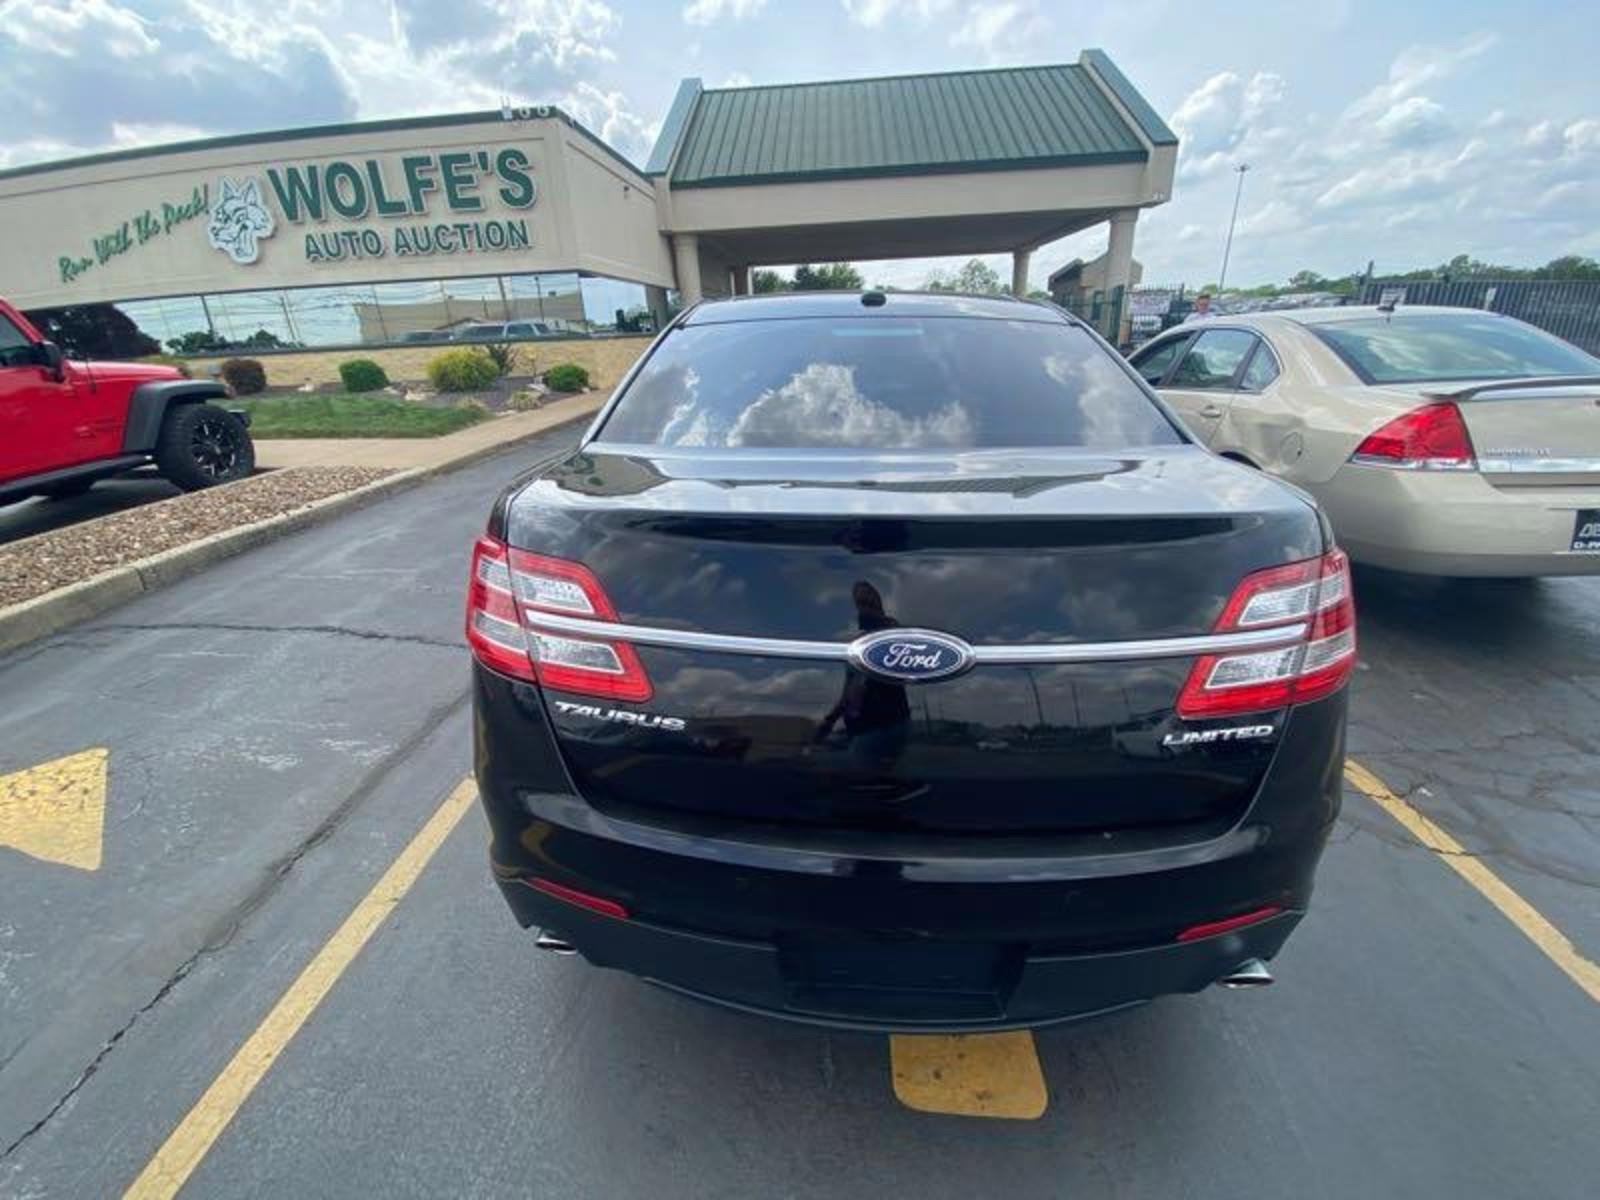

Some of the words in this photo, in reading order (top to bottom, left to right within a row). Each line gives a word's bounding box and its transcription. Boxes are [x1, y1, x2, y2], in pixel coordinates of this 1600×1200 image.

[267, 148, 535, 223] WOLFE'S
[58, 256, 94, 283] Run
[94, 221, 134, 266] With
[133, 210, 162, 246] The
[305, 228, 384, 261] AUTO
[395, 219, 531, 256] AUCTION
[883, 643, 942, 669] Ford
[555, 701, 686, 731] TAURUS
[1162, 725, 1275, 746] LIMITED
